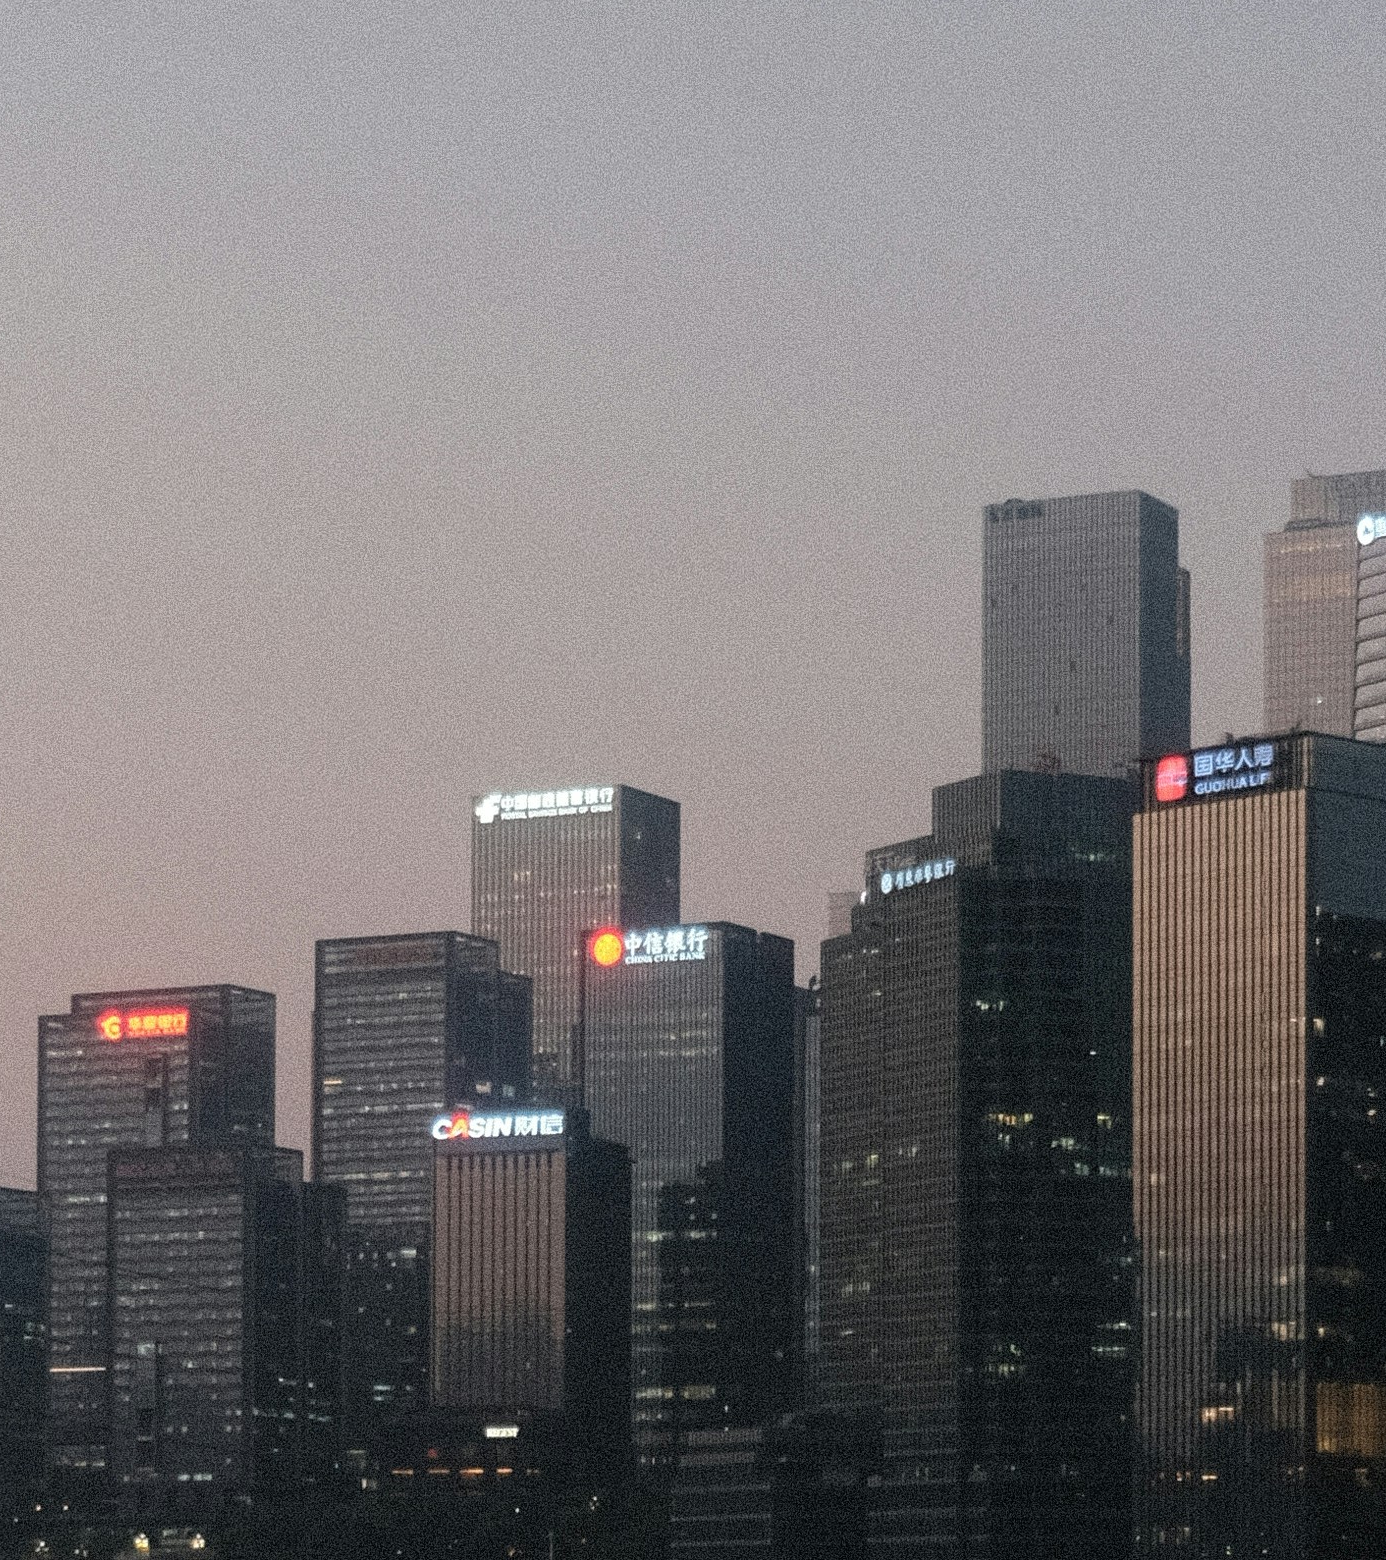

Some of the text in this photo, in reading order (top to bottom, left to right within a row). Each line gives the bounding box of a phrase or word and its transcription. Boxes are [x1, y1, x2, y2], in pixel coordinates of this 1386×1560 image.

[624, 928, 709, 956] 中信银行
[432, 1114, 512, 1140] CASIN
